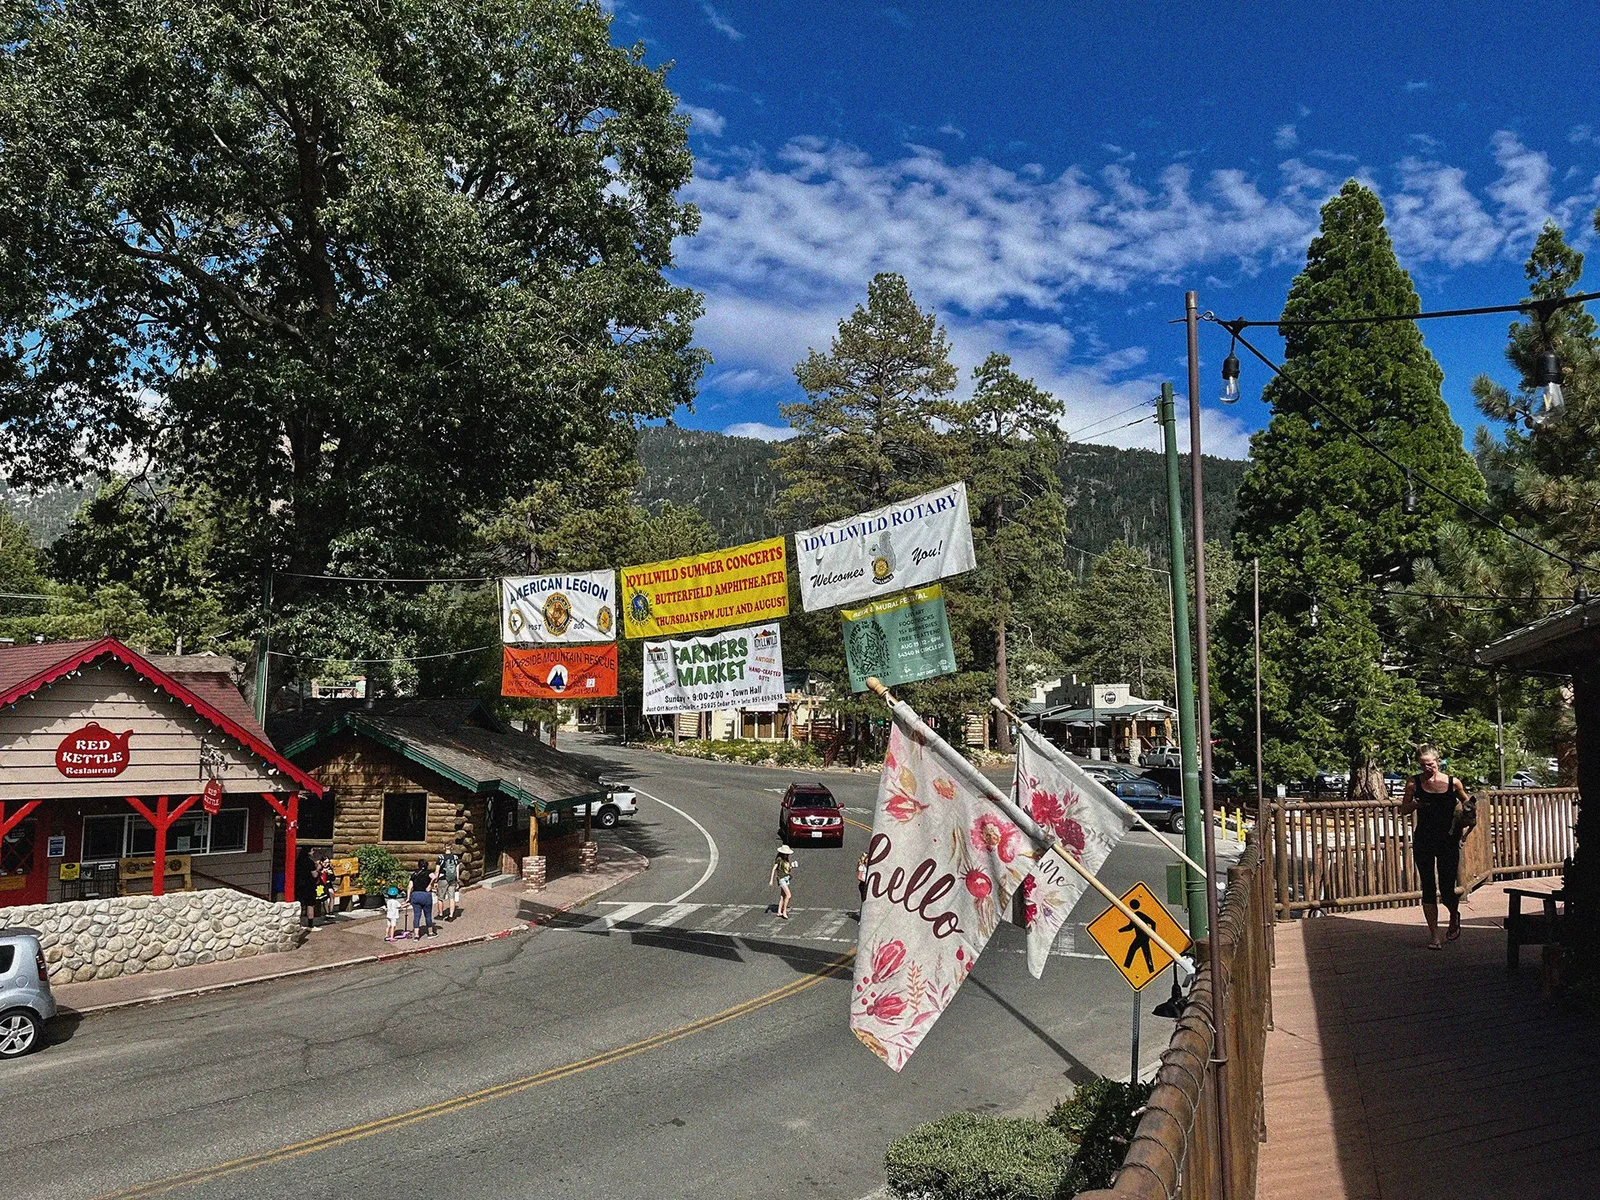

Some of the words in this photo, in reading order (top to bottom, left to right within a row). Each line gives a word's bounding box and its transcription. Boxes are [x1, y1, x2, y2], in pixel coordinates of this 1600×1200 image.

[804, 517, 888, 552] IDYLLWILD
[891, 493, 957, 527] ROTARY
[911, 540, 943, 566] You!
[626, 569, 679, 588] IDYLLWILD
[680, 559, 724, 581] SUMMER
[726, 546, 783, 571] CONCERTS
[810, 568, 865, 588] Welcomes
[510, 577, 562, 604] AMERICAN
[566, 577, 608, 601] LEGION
[655, 585, 713, 605] BUTTERFIELD
[714, 570, 784, 596] AMPHITHEATER
[655, 611, 699, 627] THURSDAYS
[700, 609, 714, 621] 6PM
[715, 605, 735, 618] JULY
[736, 602, 753, 615] AND
[754, 596, 786, 613] AUGUST
[875, 602, 899, 612] MURAL
[504, 653, 542, 672] RIVERSIDE
[543, 651, 582, 663] MOUNTAIN
[584, 653, 615, 671] RESCUE
[673, 636, 749, 666] FARMERS
[676, 660, 747, 687] MARKET
[664, 694, 686, 704] Sunday
[731, 688, 749, 697] Town
[749, 685, 762, 695] Hall
[75, 739, 111, 750] RED
[62, 752, 123, 764] KETTLE
[65, 767, 117, 775] Restaurant
[865, 832, 964, 939] hello
